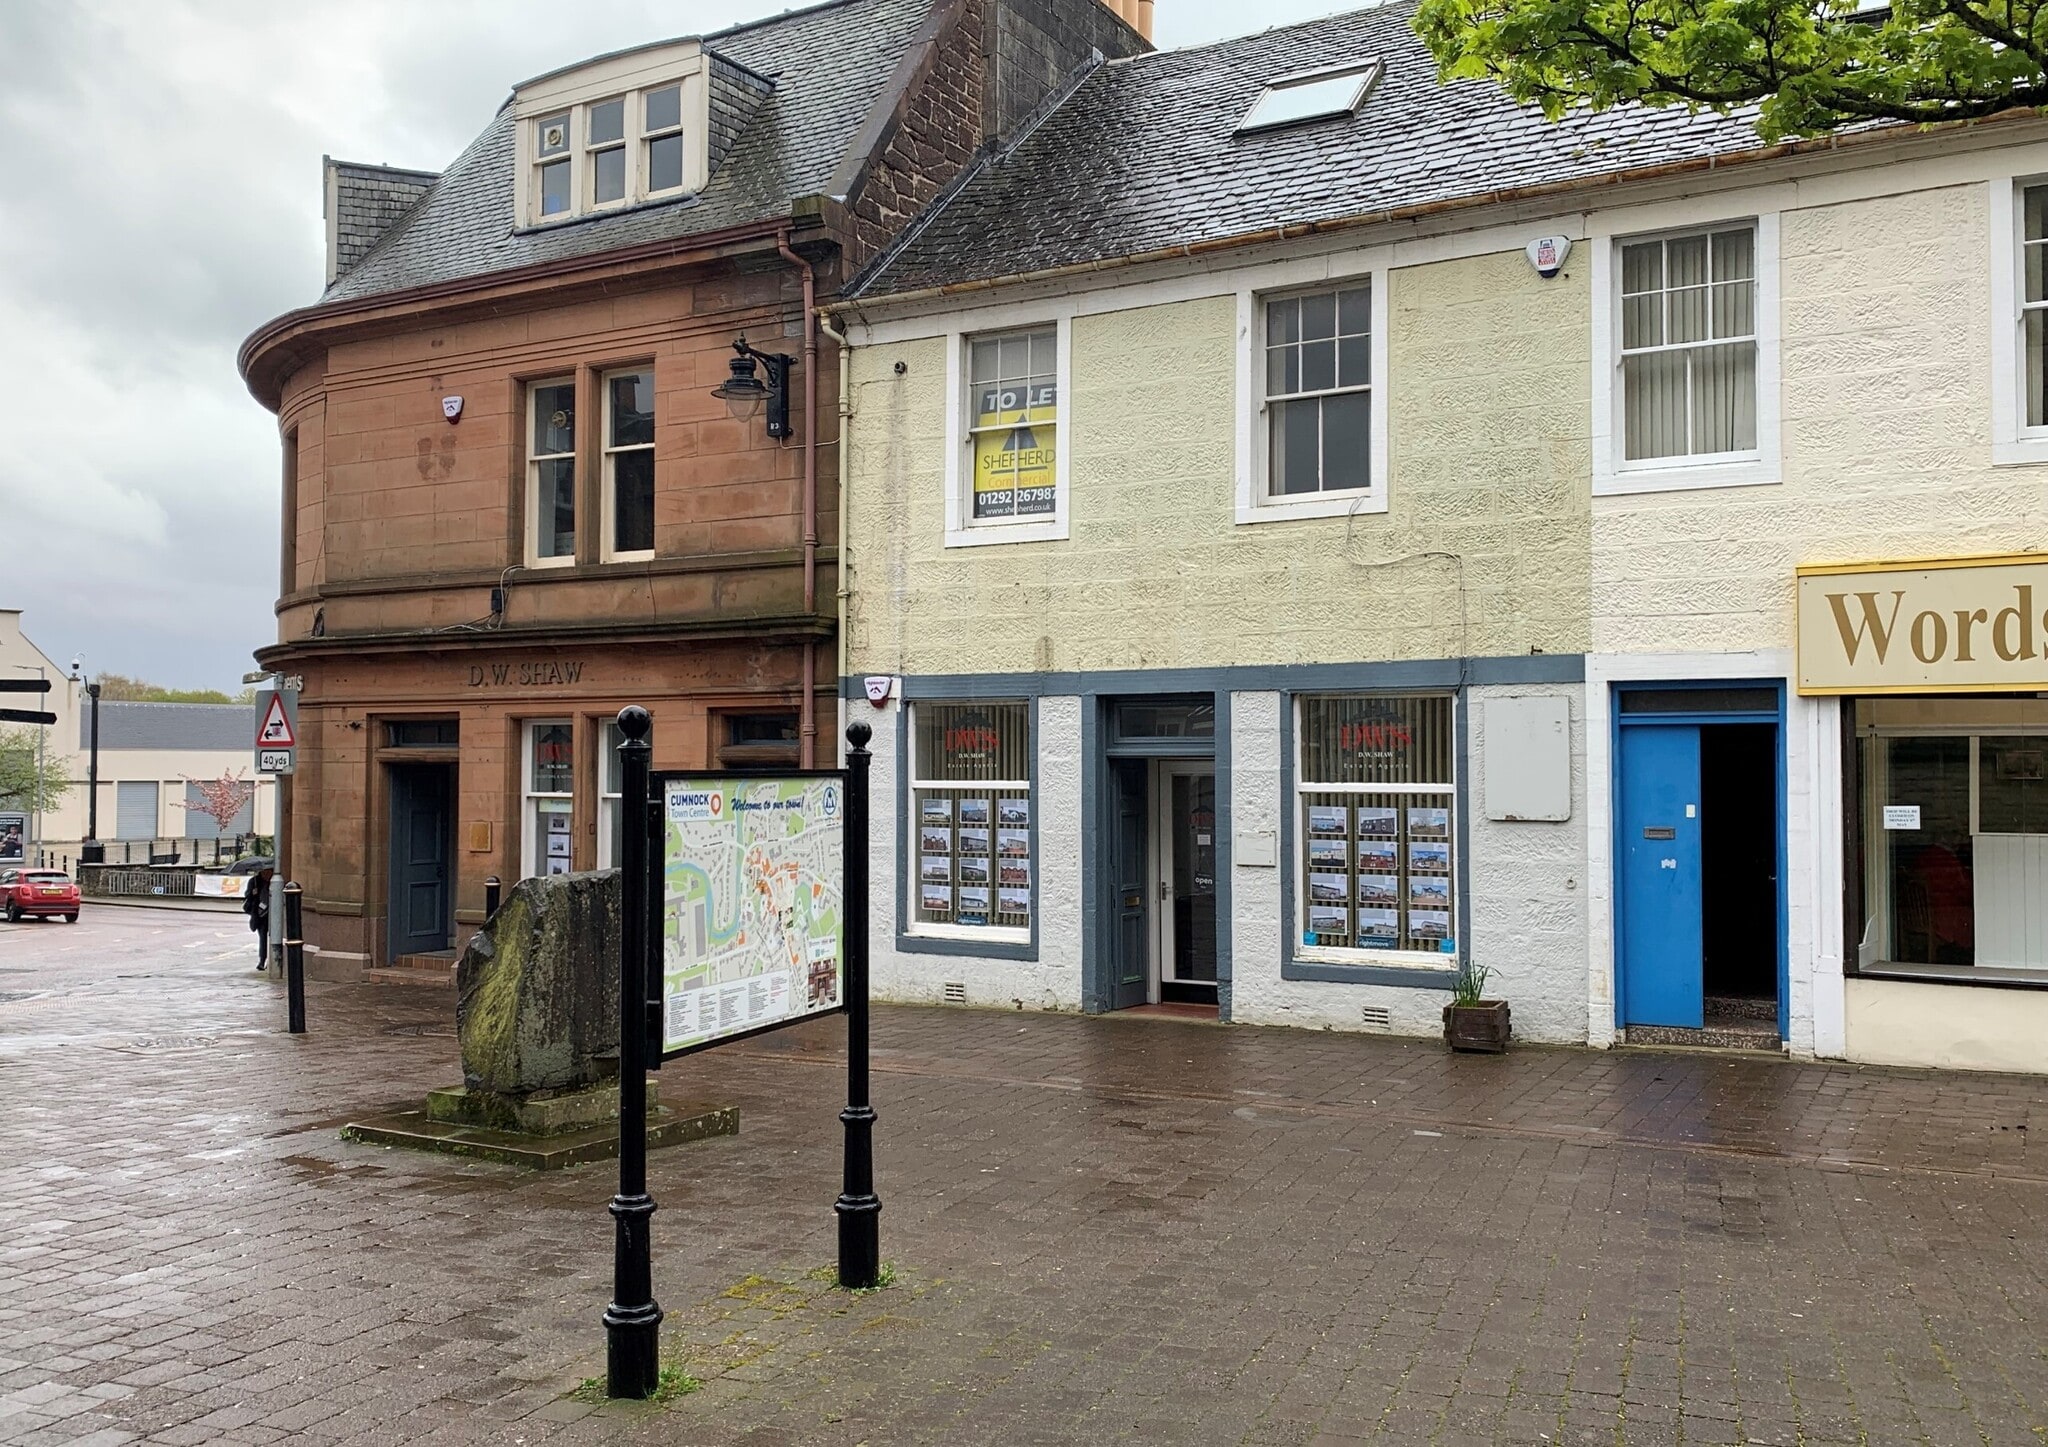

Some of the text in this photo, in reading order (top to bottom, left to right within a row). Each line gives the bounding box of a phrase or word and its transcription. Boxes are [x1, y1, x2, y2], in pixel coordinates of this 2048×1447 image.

[987, 387, 1056, 410] TO LE
[979, 490, 1012, 506] 01292
[1825, 584, 2048, 667] Word
[468, 661, 585, 687] D.W. SHAW
[263, 755, 287, 767] 40 yds
[670, 793, 710, 807] CUMNOCK
[731, 797, 763, 812] Welcome
[763, 800, 772, 810] to
[773, 802, 784, 810] our
[671, 807, 710, 819] Town Centre
[1195, 876, 1213, 886] open
[1359, 940, 1389, 948] rightmove
